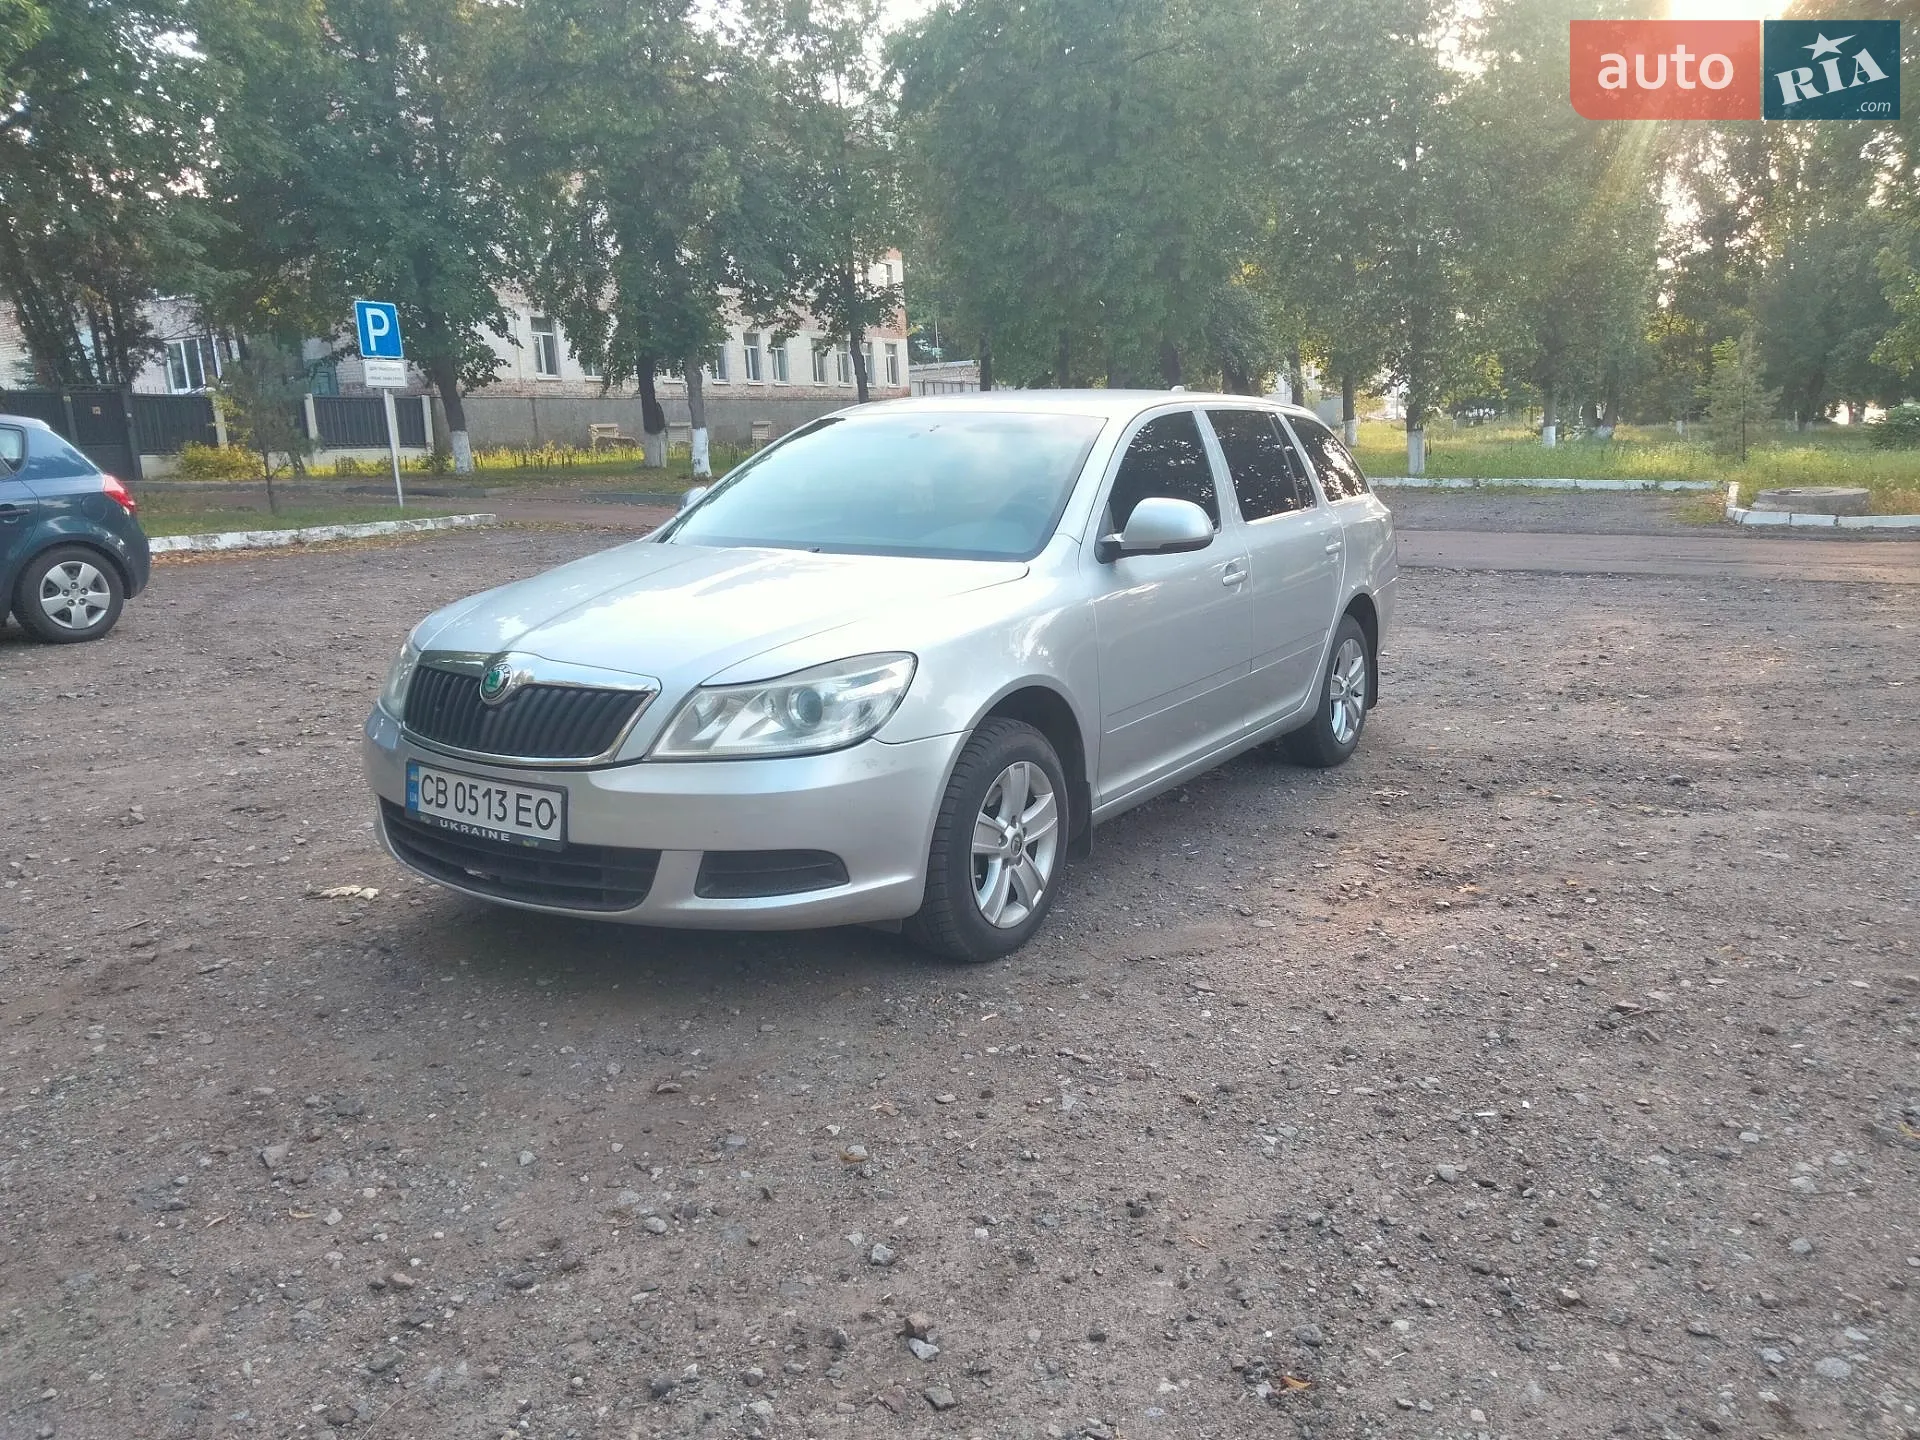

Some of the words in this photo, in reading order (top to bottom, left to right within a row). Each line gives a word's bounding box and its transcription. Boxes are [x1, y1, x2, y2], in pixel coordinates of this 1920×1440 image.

[365, 308, 390, 352] P
[421, 774, 448, 809] CB
[455, 782, 507, 822] 0513
[515, 793, 556, 830] EO
[439, 819, 511, 842] UKRAINE
